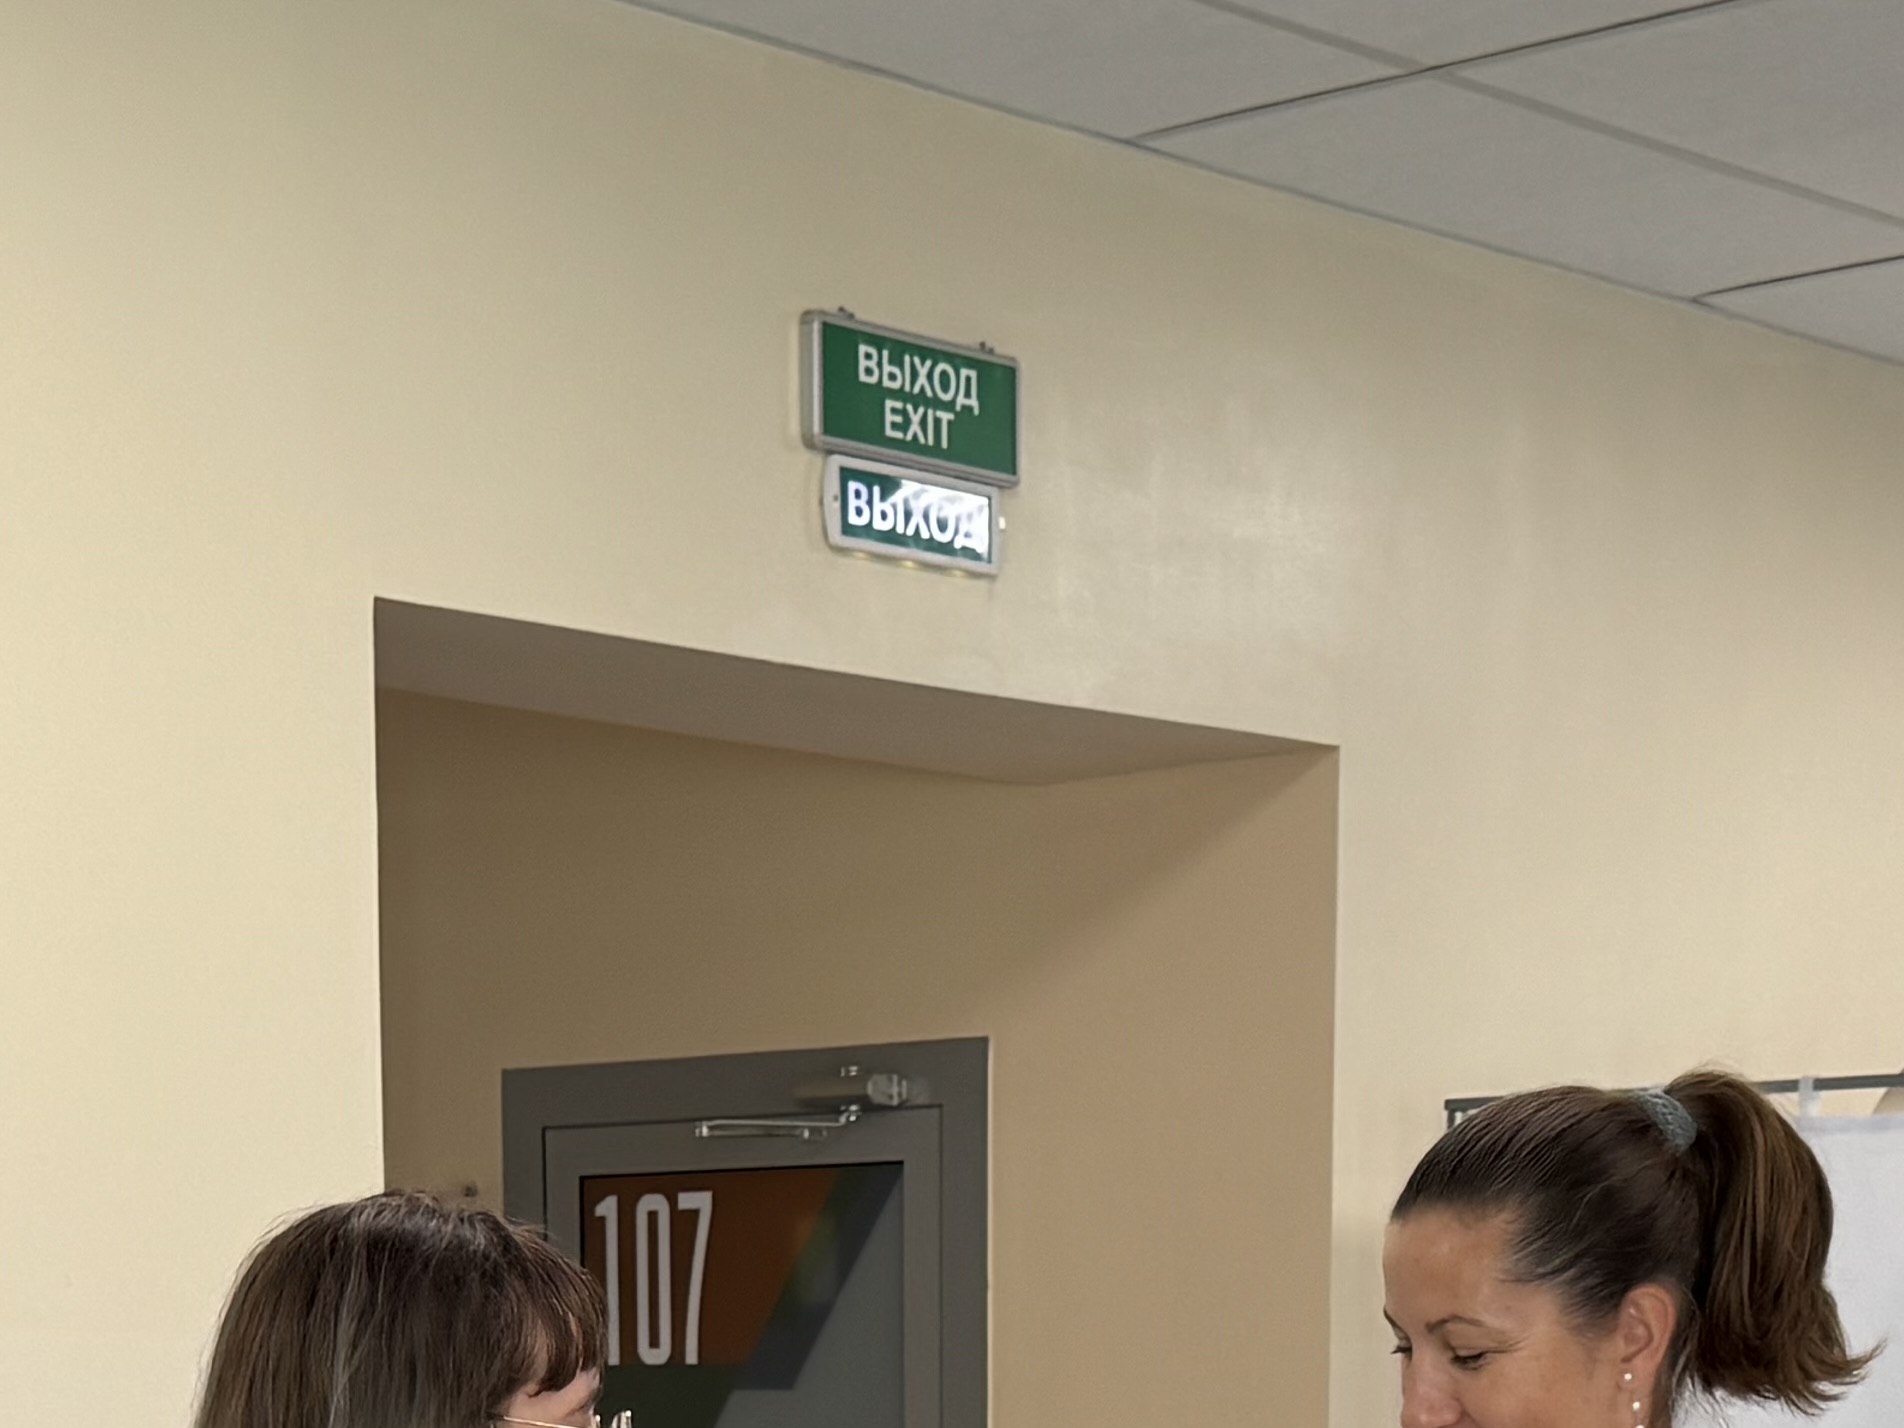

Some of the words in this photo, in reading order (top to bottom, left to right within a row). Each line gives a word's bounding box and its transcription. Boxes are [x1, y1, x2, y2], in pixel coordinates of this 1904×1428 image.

[857, 343, 980, 416] ВЫХОД
[884, 399, 955, 450] EXIT
[594, 1190, 713, 1366] 107
